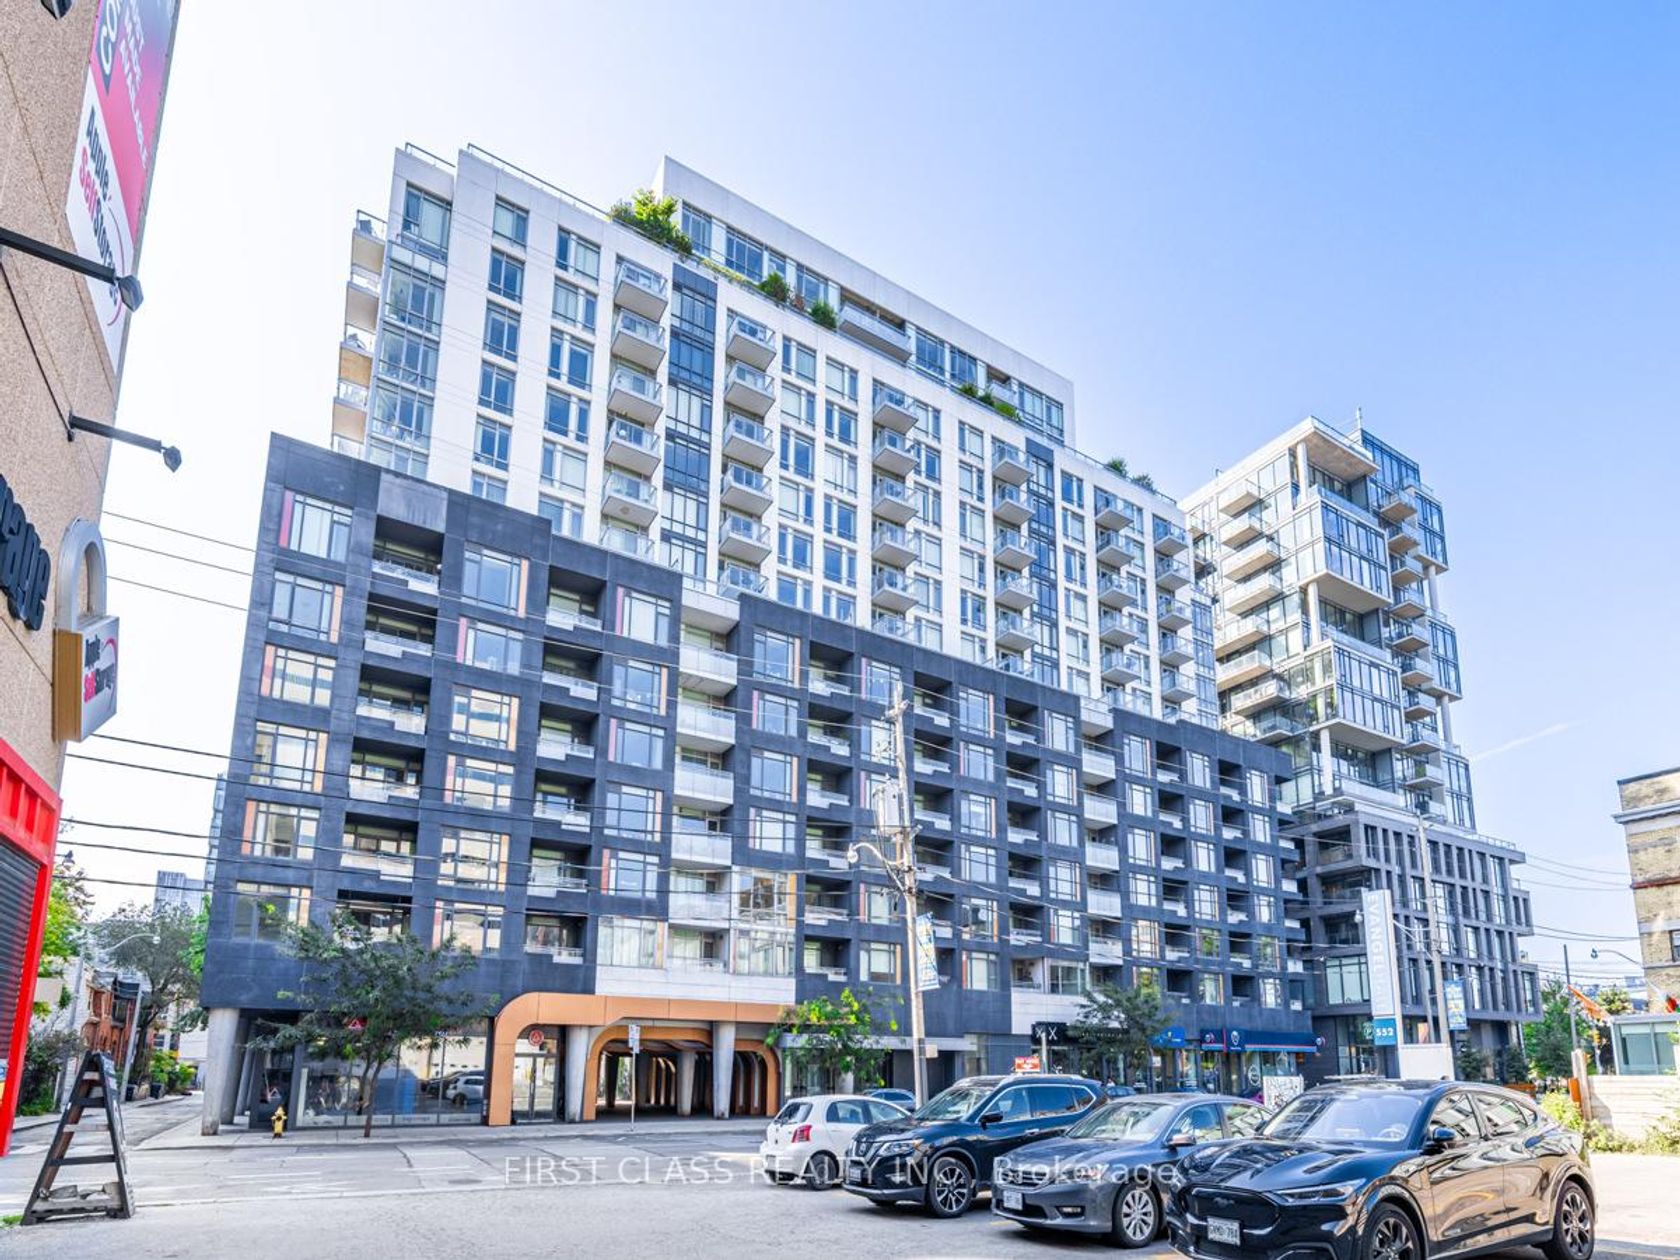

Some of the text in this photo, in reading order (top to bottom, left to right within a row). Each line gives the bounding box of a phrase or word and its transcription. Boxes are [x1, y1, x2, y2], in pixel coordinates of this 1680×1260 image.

[86, 105, 110, 202] Apple
[79, 146, 120, 306] SelfStore
[1368, 893, 1385, 972] EVANGEL
[1376, 1027, 1394, 1036] 552
